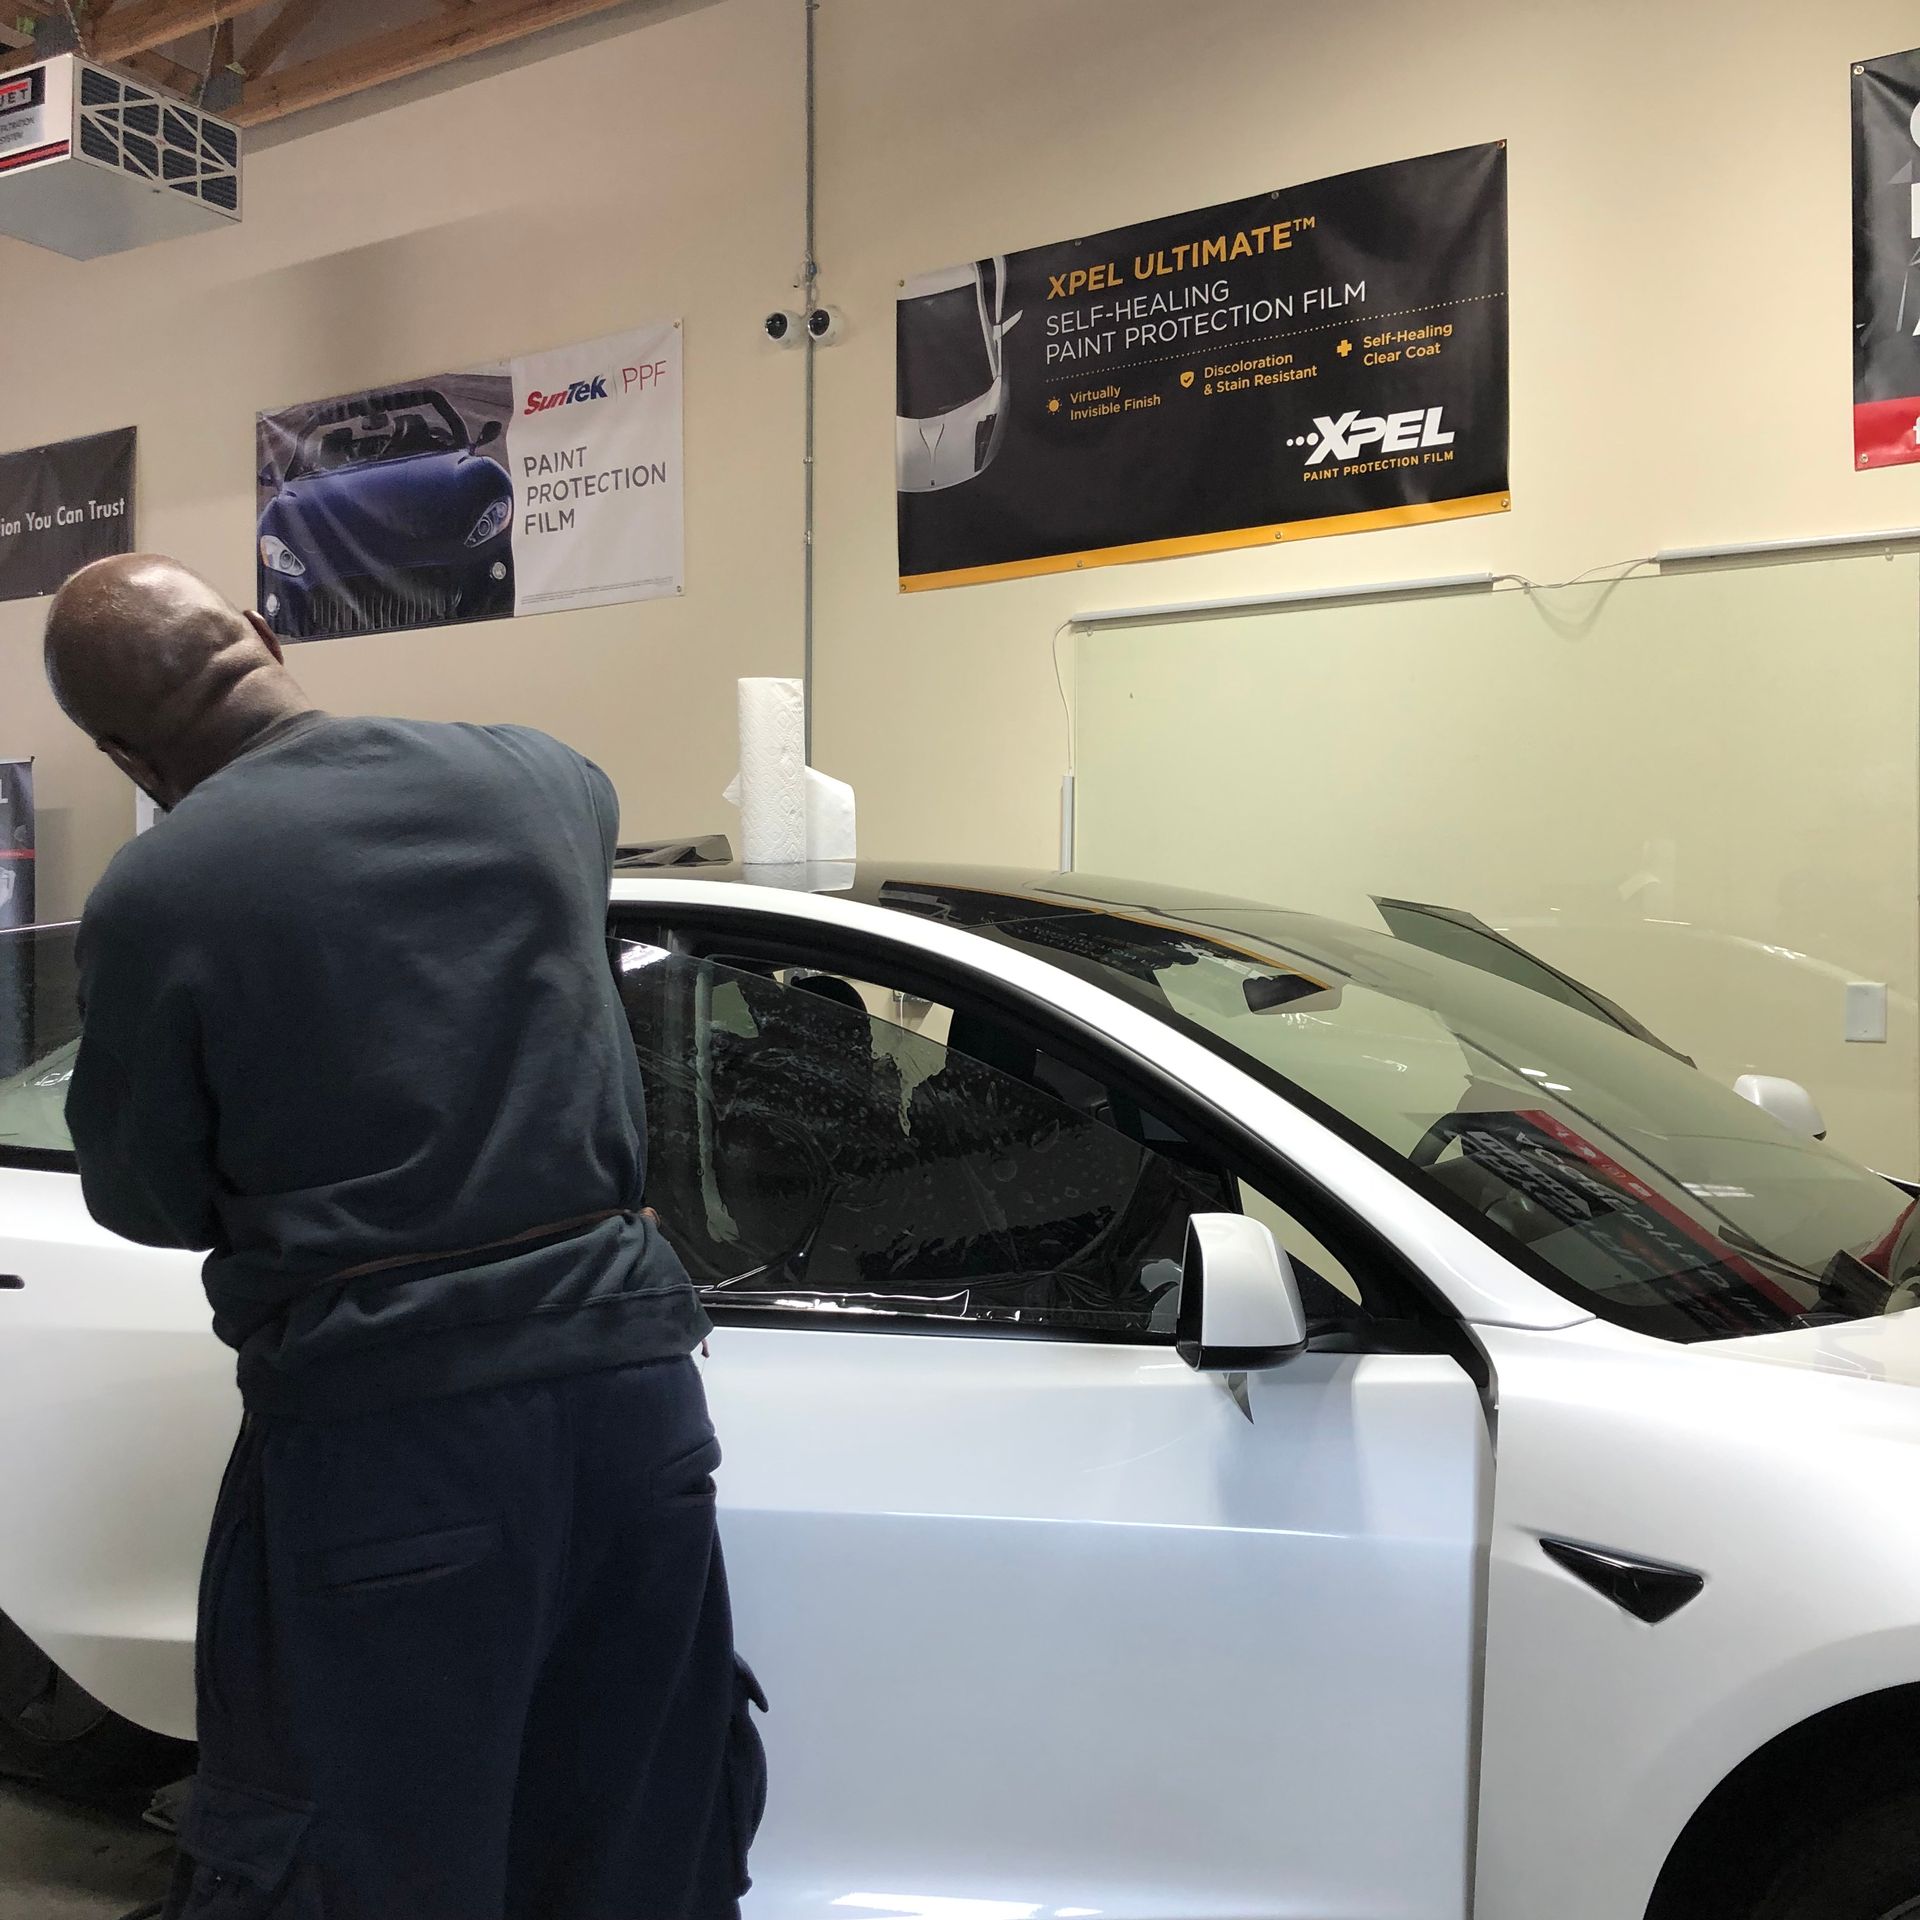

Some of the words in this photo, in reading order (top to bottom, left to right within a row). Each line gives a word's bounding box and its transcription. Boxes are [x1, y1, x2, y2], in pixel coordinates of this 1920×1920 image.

[1047, 262, 1124, 300] XPEL
[1046, 279, 1230, 336] SELF-HEALING
[1046, 330, 1117, 365] PAINT
[1125, 294, 1293, 349] PROTECTION
[1303, 280, 1366, 314] FILM
[1363, 323, 1453, 349] Self-Healing
[1203, 353, 1293, 379] Discoloration
[1363, 350, 1402, 367] Clear
[1405, 342, 1441, 359] Coat
[524, 375, 608, 416] SunTek
[622, 360, 667, 394] PPF
[1069, 384, 1121, 405] Virtually
[1203, 383, 1213, 396] &
[1216, 378, 1251, 394] Stain
[1254, 364, 1318, 387] Resistant
[1069, 401, 1121, 421] Invisible
[1124, 393, 1161, 411] Finish
[1304, 406, 1456, 466] XPEL
[524, 446, 588, 478] PAINT
[1303, 467, 1340, 482] PAINT
[1343, 454, 1419, 477] PROTECTION
[1423, 450, 1455, 464] FILM
[526, 461, 666, 507] PROTECTION
[25, 511, 52, 532] You
[56, 505, 84, 526] Can
[88, 497, 125, 520] Trust
[524, 508, 576, 536] FILM
